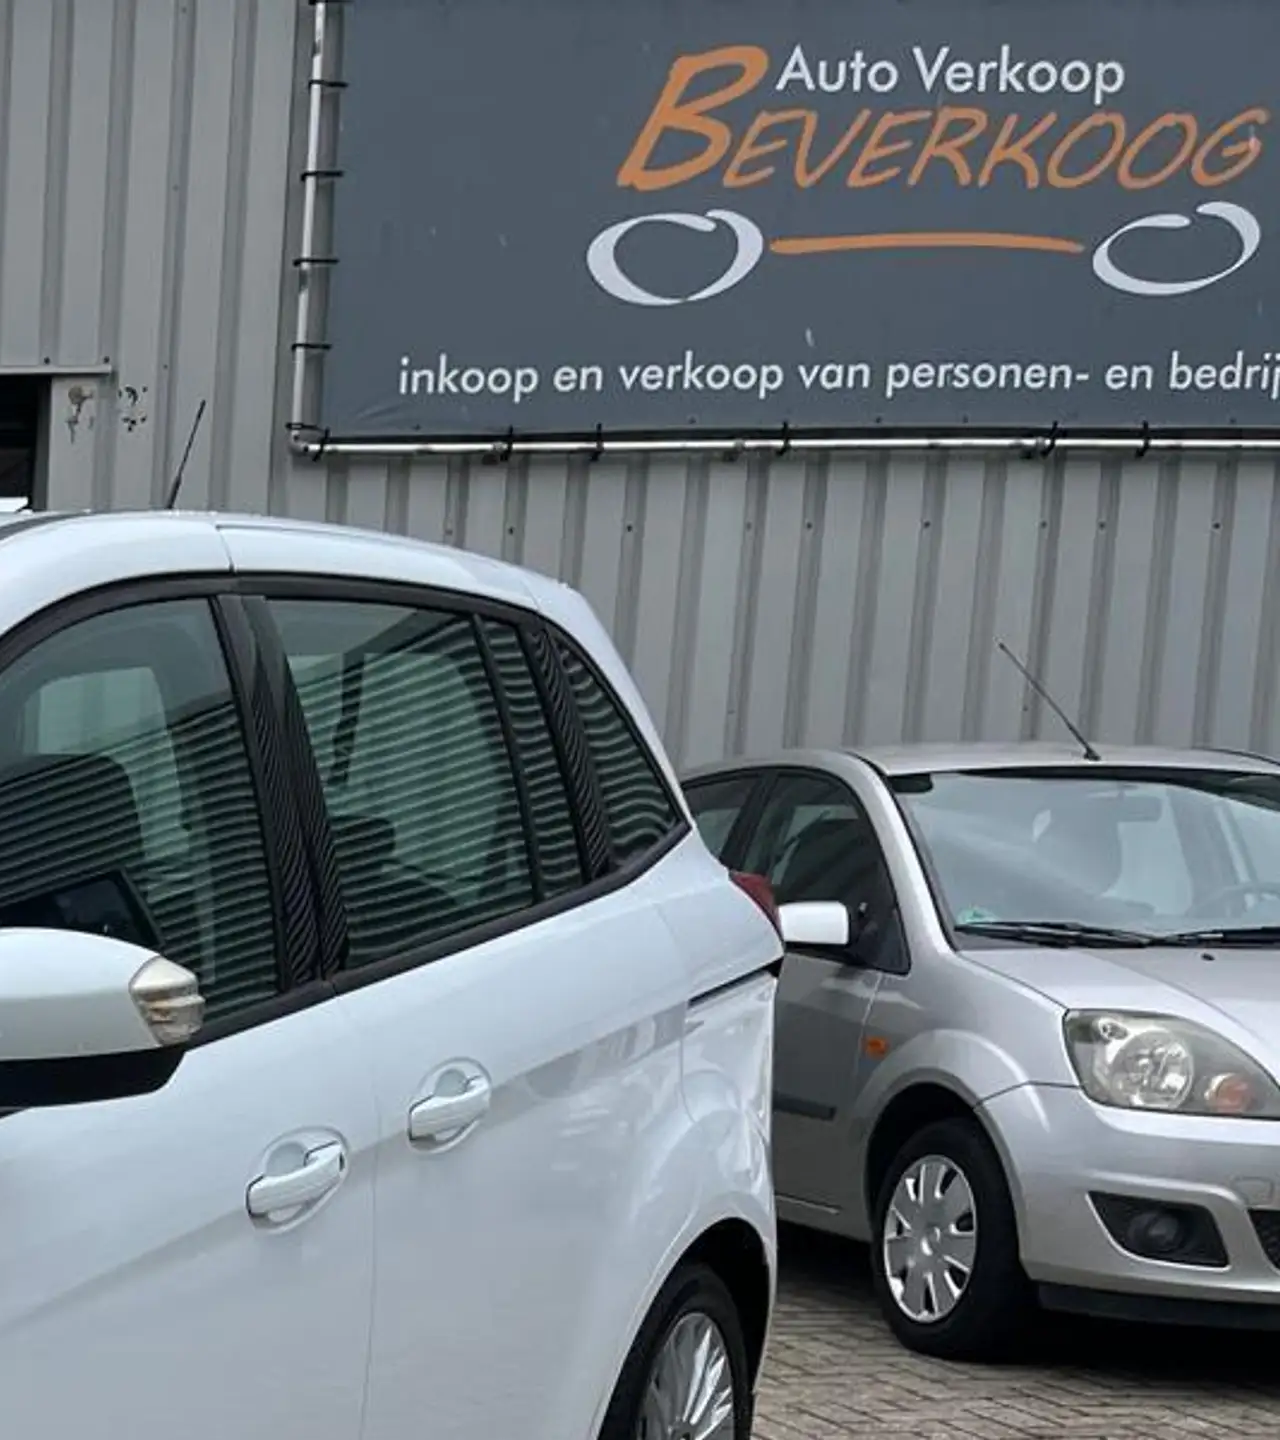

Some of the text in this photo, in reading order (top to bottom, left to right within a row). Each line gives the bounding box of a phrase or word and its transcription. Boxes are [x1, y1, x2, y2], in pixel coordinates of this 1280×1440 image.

[775, 44, 1125, 105] Auto Verkoop
[616, 45, 1270, 190] BEVERKOOG
[399, 354, 539, 402] inkoop
[553, 365, 603, 391] en
[619, 350, 783, 399] verkoop
[799, 362, 870, 390] van
[886, 360, 1089, 398] personen-
[1105, 362, 1153, 389] en
